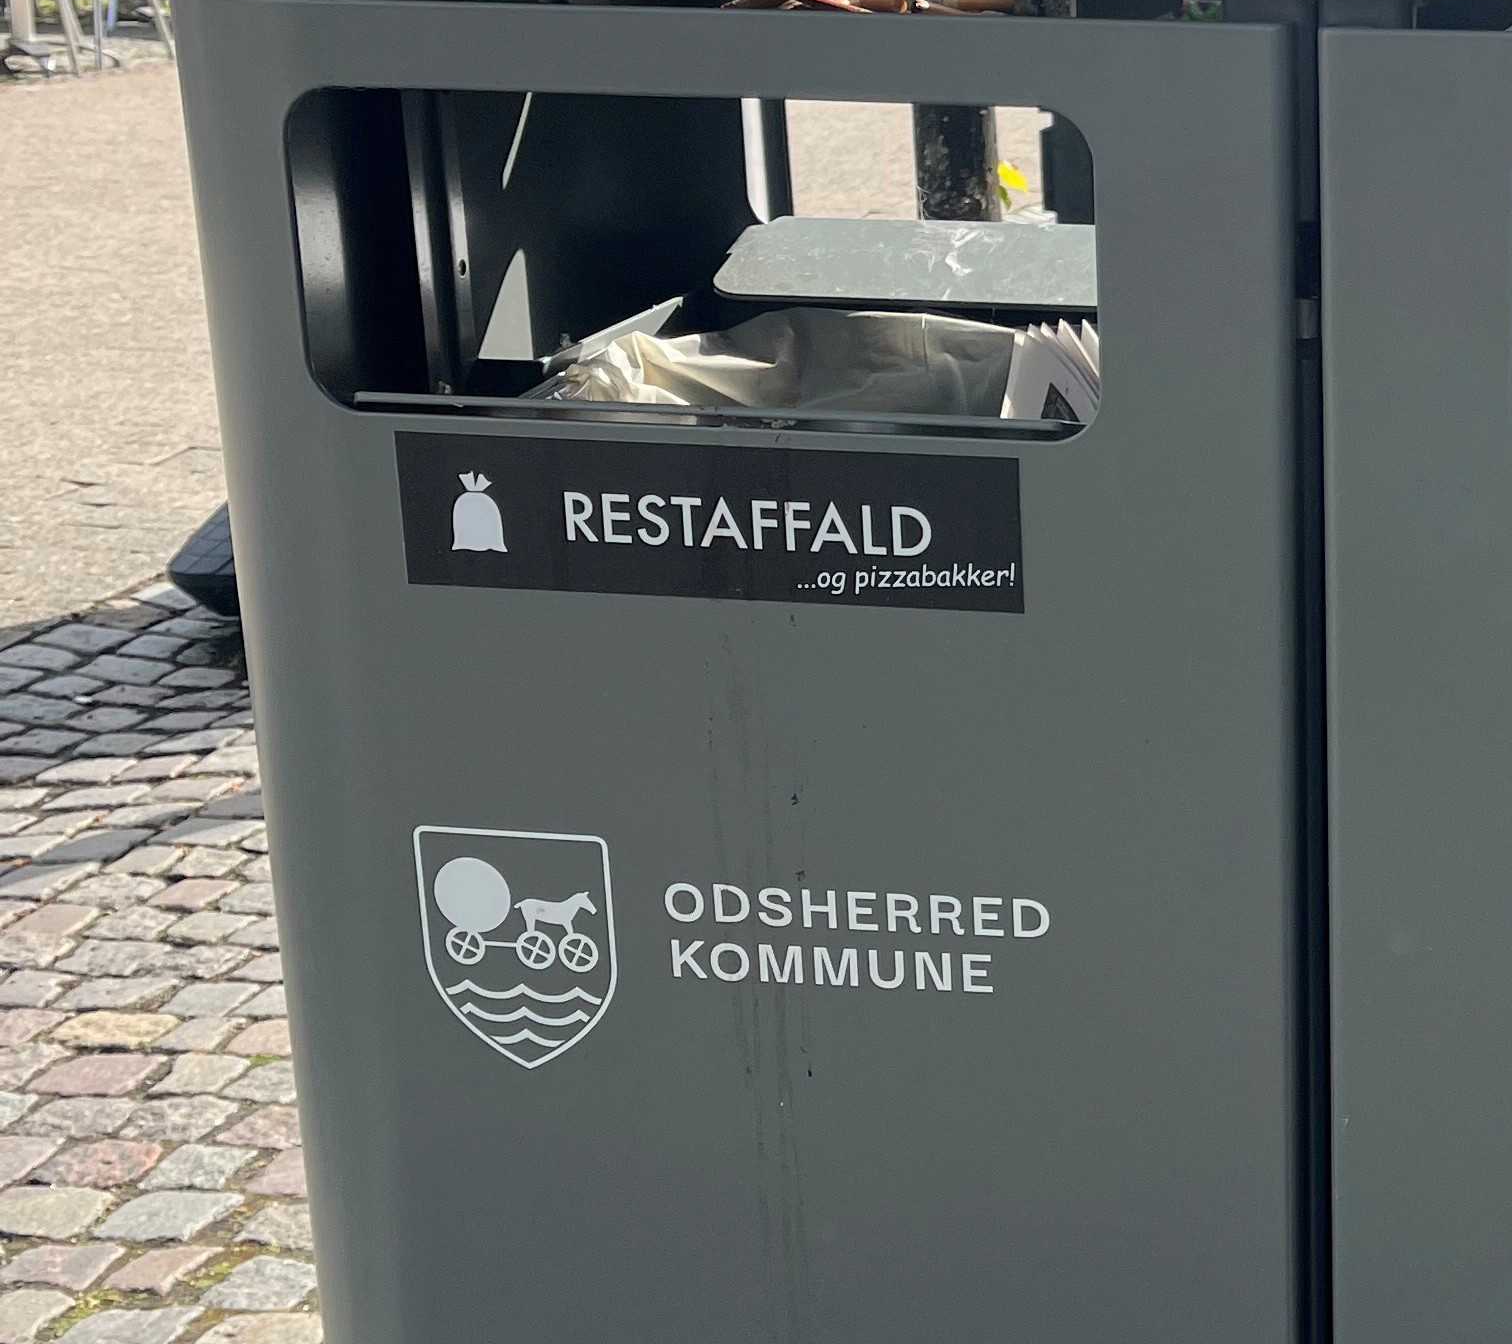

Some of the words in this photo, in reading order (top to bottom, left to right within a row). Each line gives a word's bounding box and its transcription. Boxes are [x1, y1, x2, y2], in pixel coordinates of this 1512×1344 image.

[564, 492, 931, 556] RESTAFFALD
[798, 572, 846, 594] ...og
[856, 563, 1014, 594] pizzabakker!
[665, 883, 1049, 938] ODSHERRED
[671, 939, 994, 992] KOMMUNE
